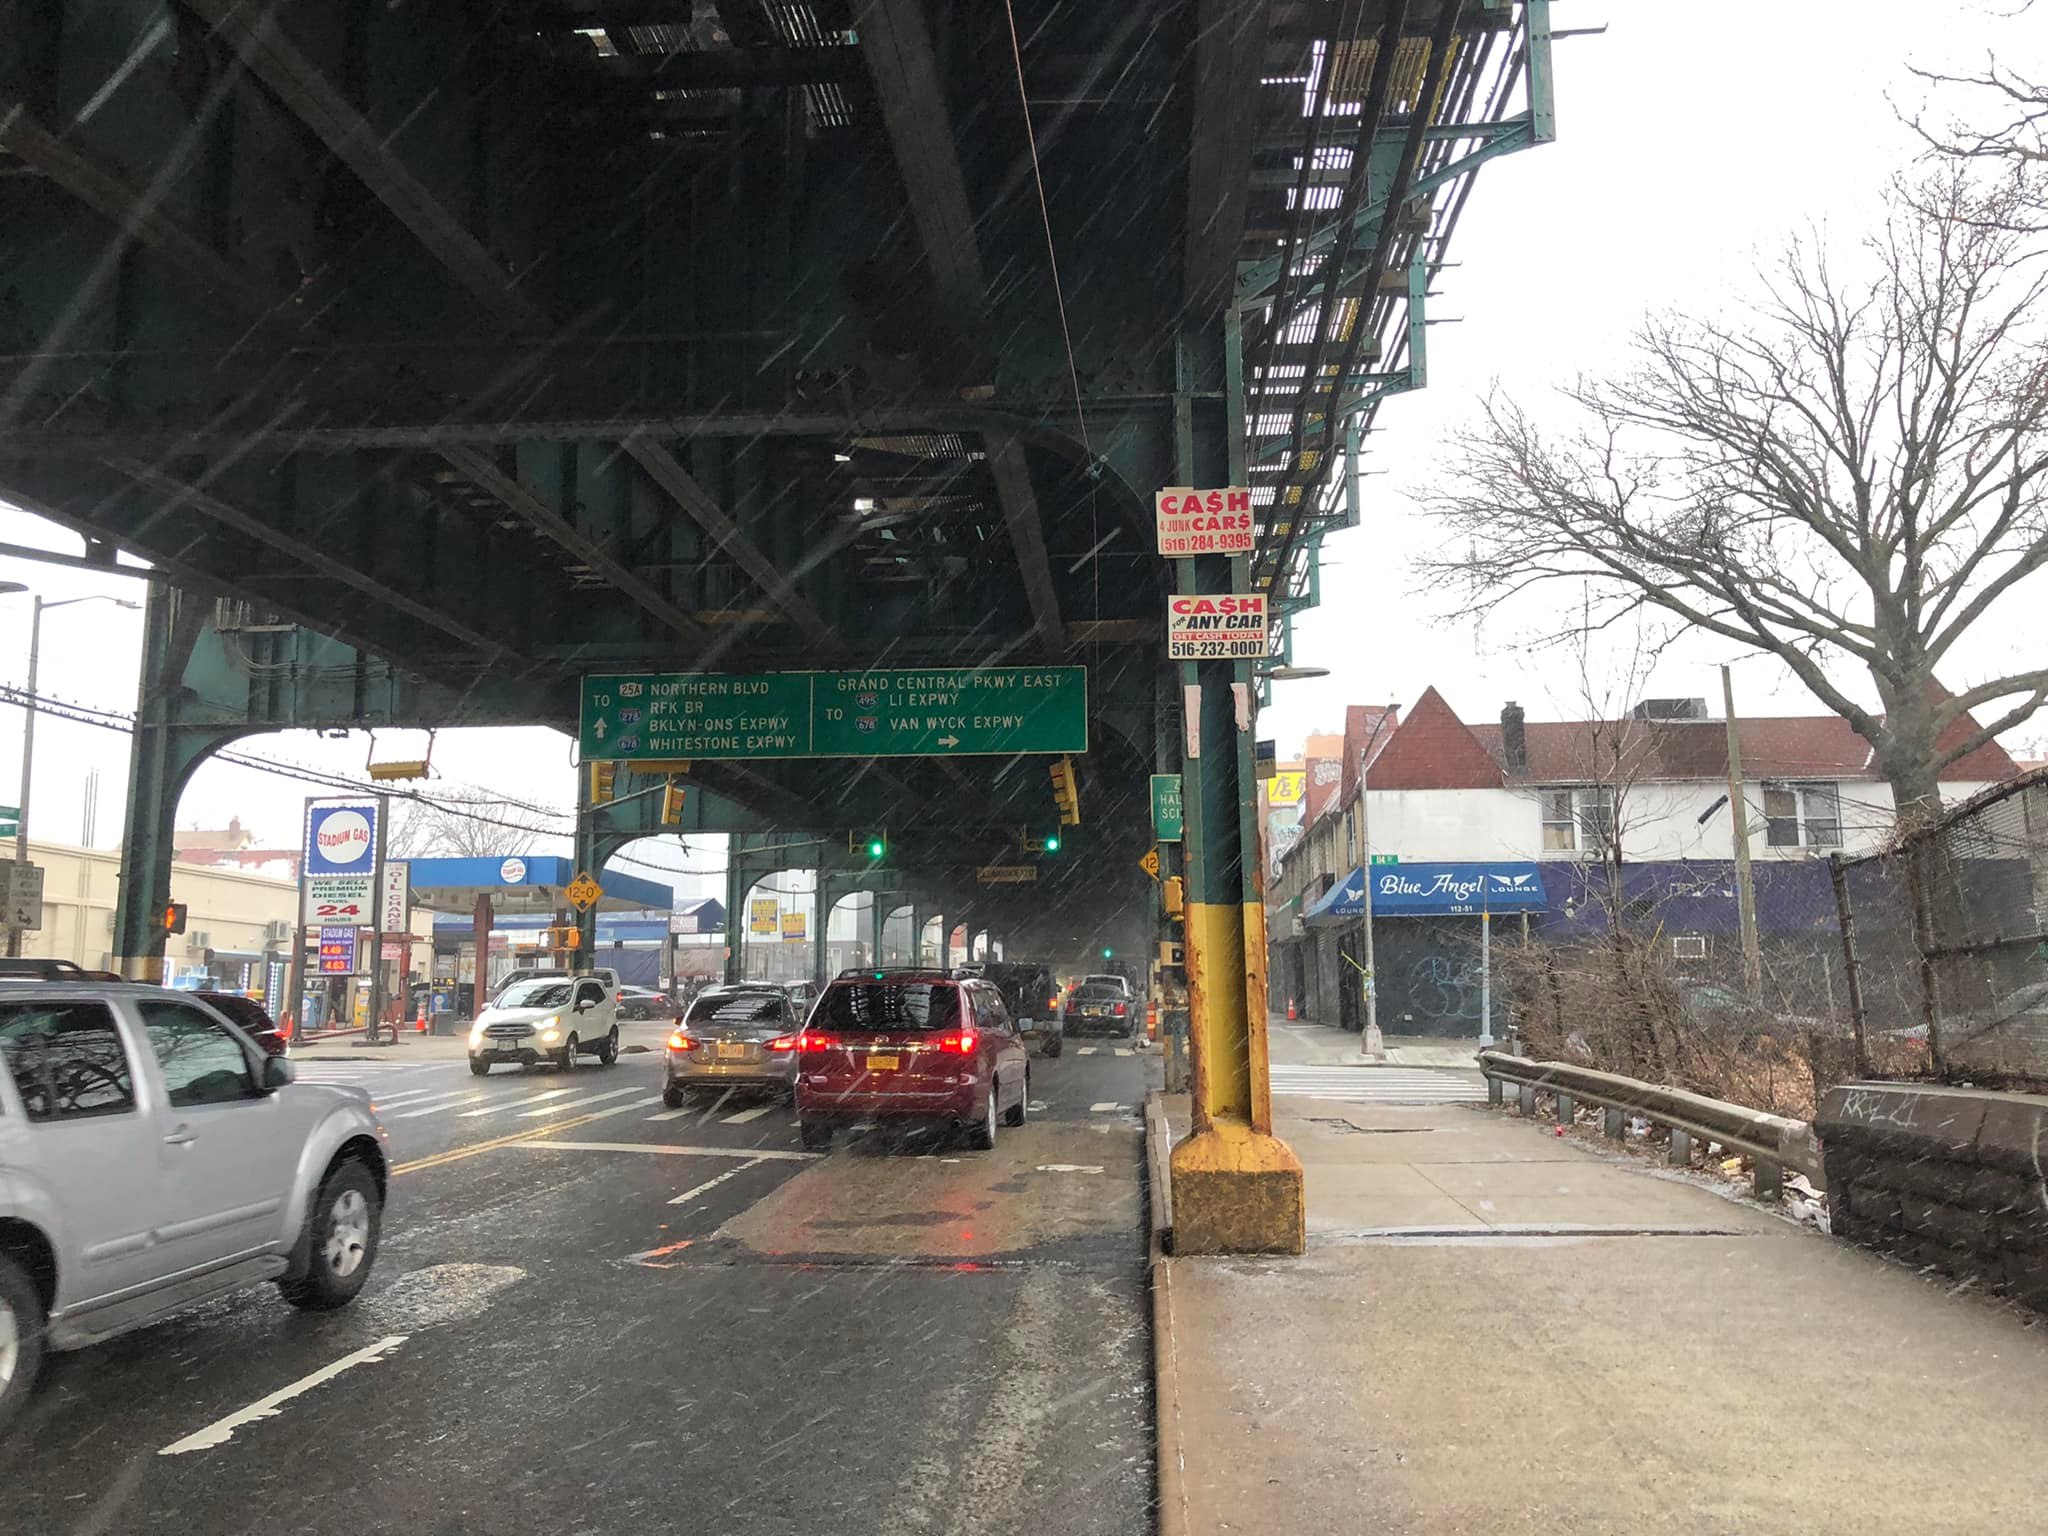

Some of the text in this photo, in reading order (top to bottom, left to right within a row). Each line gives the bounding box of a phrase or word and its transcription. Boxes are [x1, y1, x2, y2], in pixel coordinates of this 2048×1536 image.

[1160, 491, 1249, 515] CA$H
[1160, 513, 1250, 533] 4 JUNK CAR$
[1172, 597, 1262, 615] CA$H
[1172, 615, 1262, 629] FOR ANY CAR
[1173, 631, 1263, 640] GET CASH TODAY
[1172, 641, 1264, 656] 516-232-0007
[621, 683, 641, 695] 25A
[651, 682, 769, 695] NORTHERN BLVD
[837, 675, 1062, 691] GRAND CENTRAL PKWY EAST
[593, 695, 610, 707] TO
[858, 696, 876, 705] 495
[889, 693, 960, 706] LI EXPWY
[651, 701, 703, 714] RFK BR
[622, 711, 640, 721] 278
[826, 709, 843, 720] TO
[740, 718, 788, 730] EXPWY
[858, 720, 875, 729] 678
[890, 716, 1023, 730] VAN WYCK EXPWY
[620, 740, 637, 748] 678
[650, 736, 796, 750] WHITESTONE EXPWY
[1160, 794, 1182, 805] HAL
[318, 828, 369, 847] STADIUM GAS
[389, 872, 402, 890] OIL
[1380, 873, 1483, 900] Blue Angel
[316, 904, 360, 916] 24
[388, 895, 401, 931] CHANGE
[322, 928, 353, 938] STADIUM GAS
[322, 945, 342, 955] 4.49
